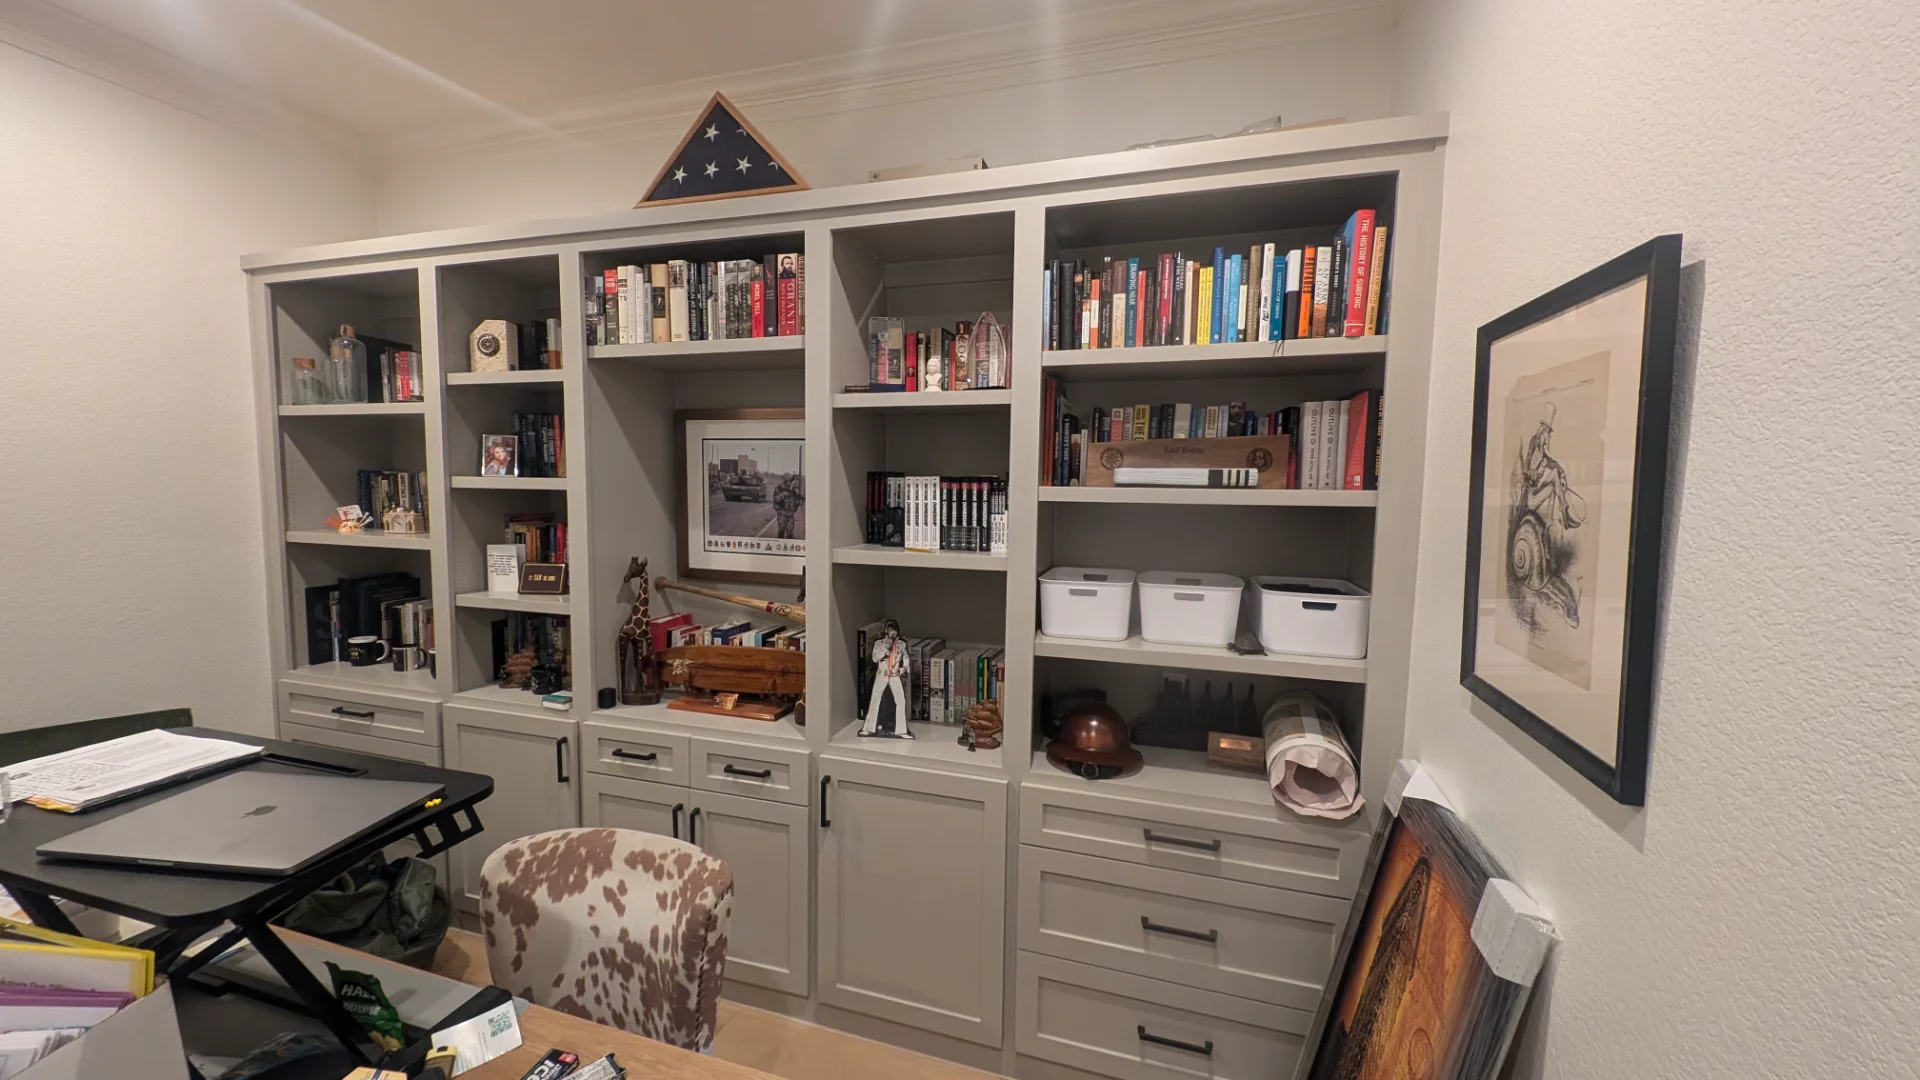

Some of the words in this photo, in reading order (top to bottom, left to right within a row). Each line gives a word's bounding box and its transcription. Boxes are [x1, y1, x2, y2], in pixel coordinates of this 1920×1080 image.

[1361, 219, 1369, 232] THE
[1358, 235, 1367, 265] HISTORY
[1376, 246, 1384, 276] SUMMER
[1129, 264, 1137, 290] DRAWING
[1303, 257, 1315, 294] PREPARED
[1317, 268, 1323, 277] AT
[1323, 267, 1329, 279] AN
[1357, 267, 1364, 276] OF
[1375, 278, 1381, 287] OF
[1353, 278, 1363, 309] SURFING
[787, 283, 795, 326] GRANT
[1135, 421, 1145, 435] THE
